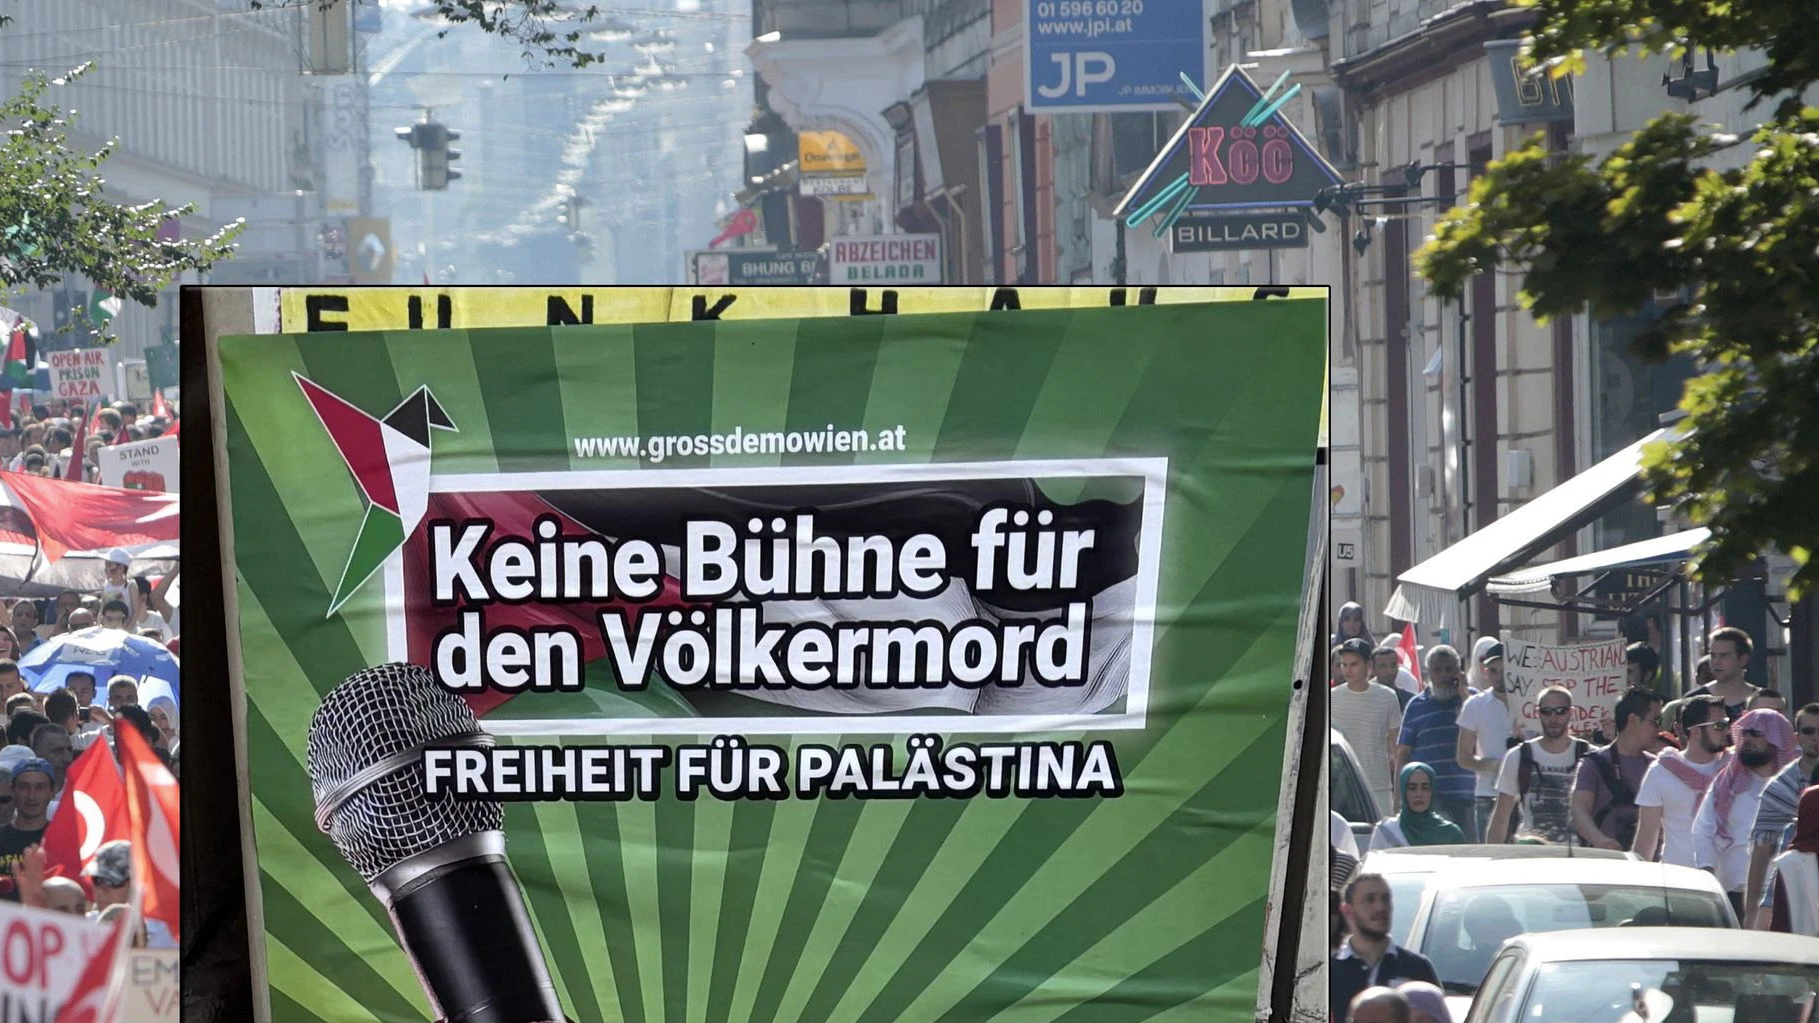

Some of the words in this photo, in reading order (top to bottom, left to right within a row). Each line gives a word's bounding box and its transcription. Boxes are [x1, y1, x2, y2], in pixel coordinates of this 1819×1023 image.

[1038, 3, 1055, 17] 01
[1060, 2, 1091, 17] 596
[1096, 1, 1118, 16] 60
[1121, 0, 1143, 15] 20
[1037, 51, 1116, 98] JP
[1189, 126, 1293, 186] Köö
[1178, 222, 1300, 243] BILLARD
[835, 239, 936, 263] ABZEICHEN
[59, 366, 100, 381] PRISON
[59, 381, 100, 396] GAZA
[119, 445, 159, 461] STAND
[574, 426, 906, 463] www.grossdemowien.at
[433, 520, 661, 601] Keine
[685, 512, 947, 599] Bühne
[971, 507, 1095, 592] für
[435, 612, 579, 690] den
[597, 601, 1088, 688] Völkermord
[1584, 675, 1622, 697] THE
[424, 748, 663, 793] FREIHEIT
[680, 739, 782, 793] FÜR
[799, 737, 1116, 791] PALÄSTINA
